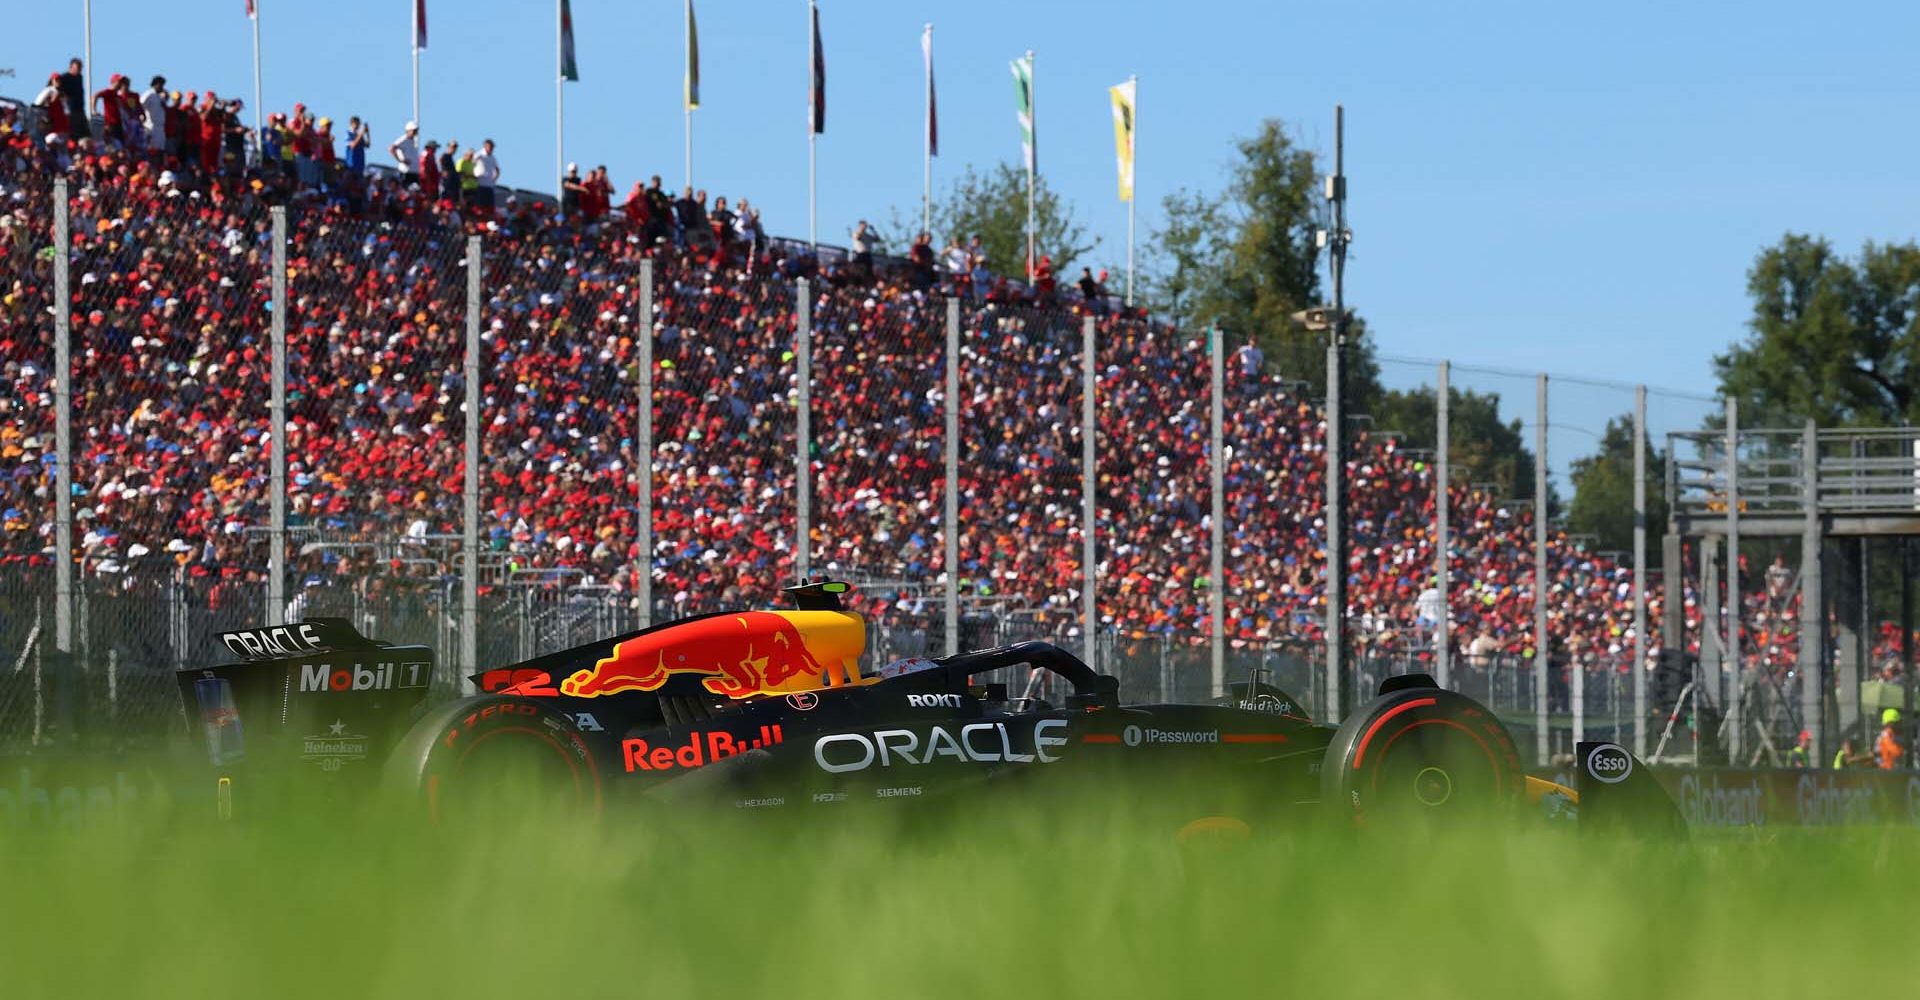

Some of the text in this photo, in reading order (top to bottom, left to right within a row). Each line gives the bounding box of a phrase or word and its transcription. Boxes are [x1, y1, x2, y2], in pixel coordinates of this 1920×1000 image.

[299, 662, 420, 692] Mobil 1
[794, 692, 812, 709] E
[906, 693, 963, 709] ROKT
[1144, 728, 1218, 744] 1Password
[304, 741, 363, 753] Heineken
[621, 731, 704, 773] Red
[814, 719, 1068, 773] ORACLE
[876, 786, 922, 798] SIEMENS
[1680, 773, 1763, 825] Globant
[744, 797, 784, 807] HEXAGON
